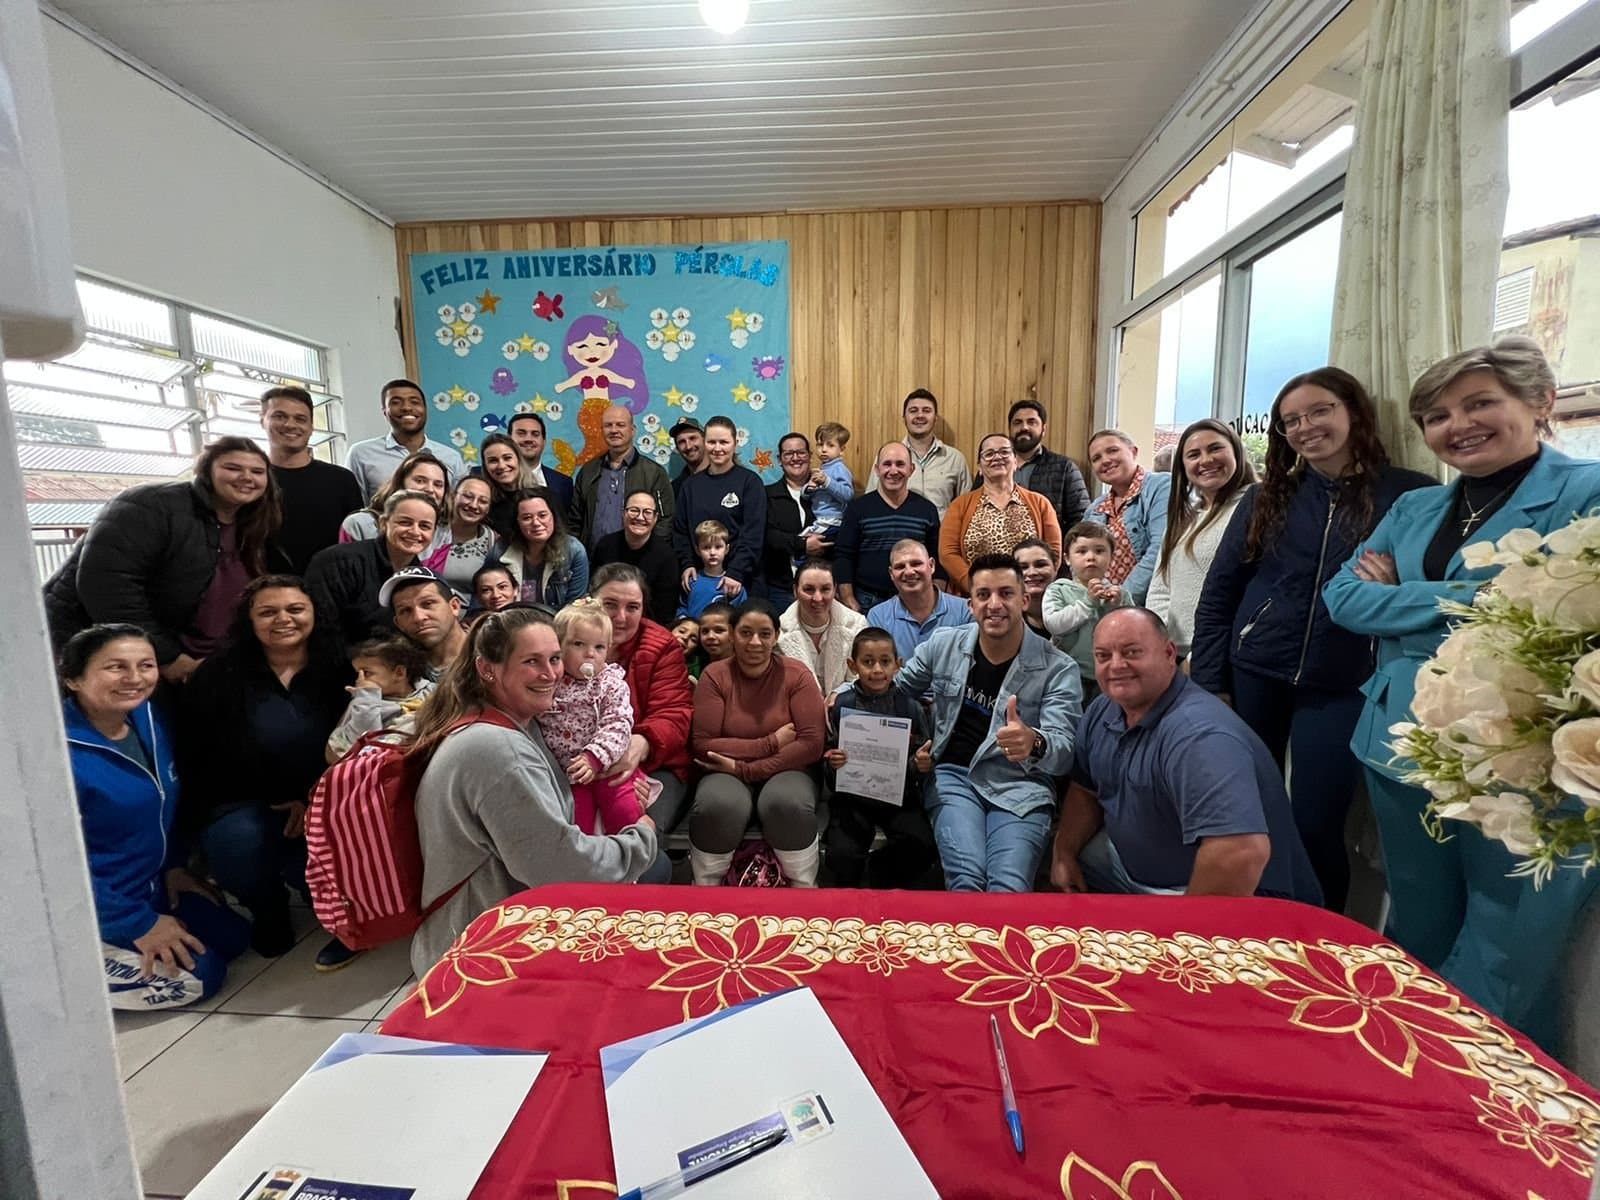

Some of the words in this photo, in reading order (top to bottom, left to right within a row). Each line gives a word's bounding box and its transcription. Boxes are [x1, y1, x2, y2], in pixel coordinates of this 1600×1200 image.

[420, 258, 489, 295] FELIZ
[503, 247, 656, 279] ANIVERSÁRIO
[674, 245, 780, 287] PÉROLAS
